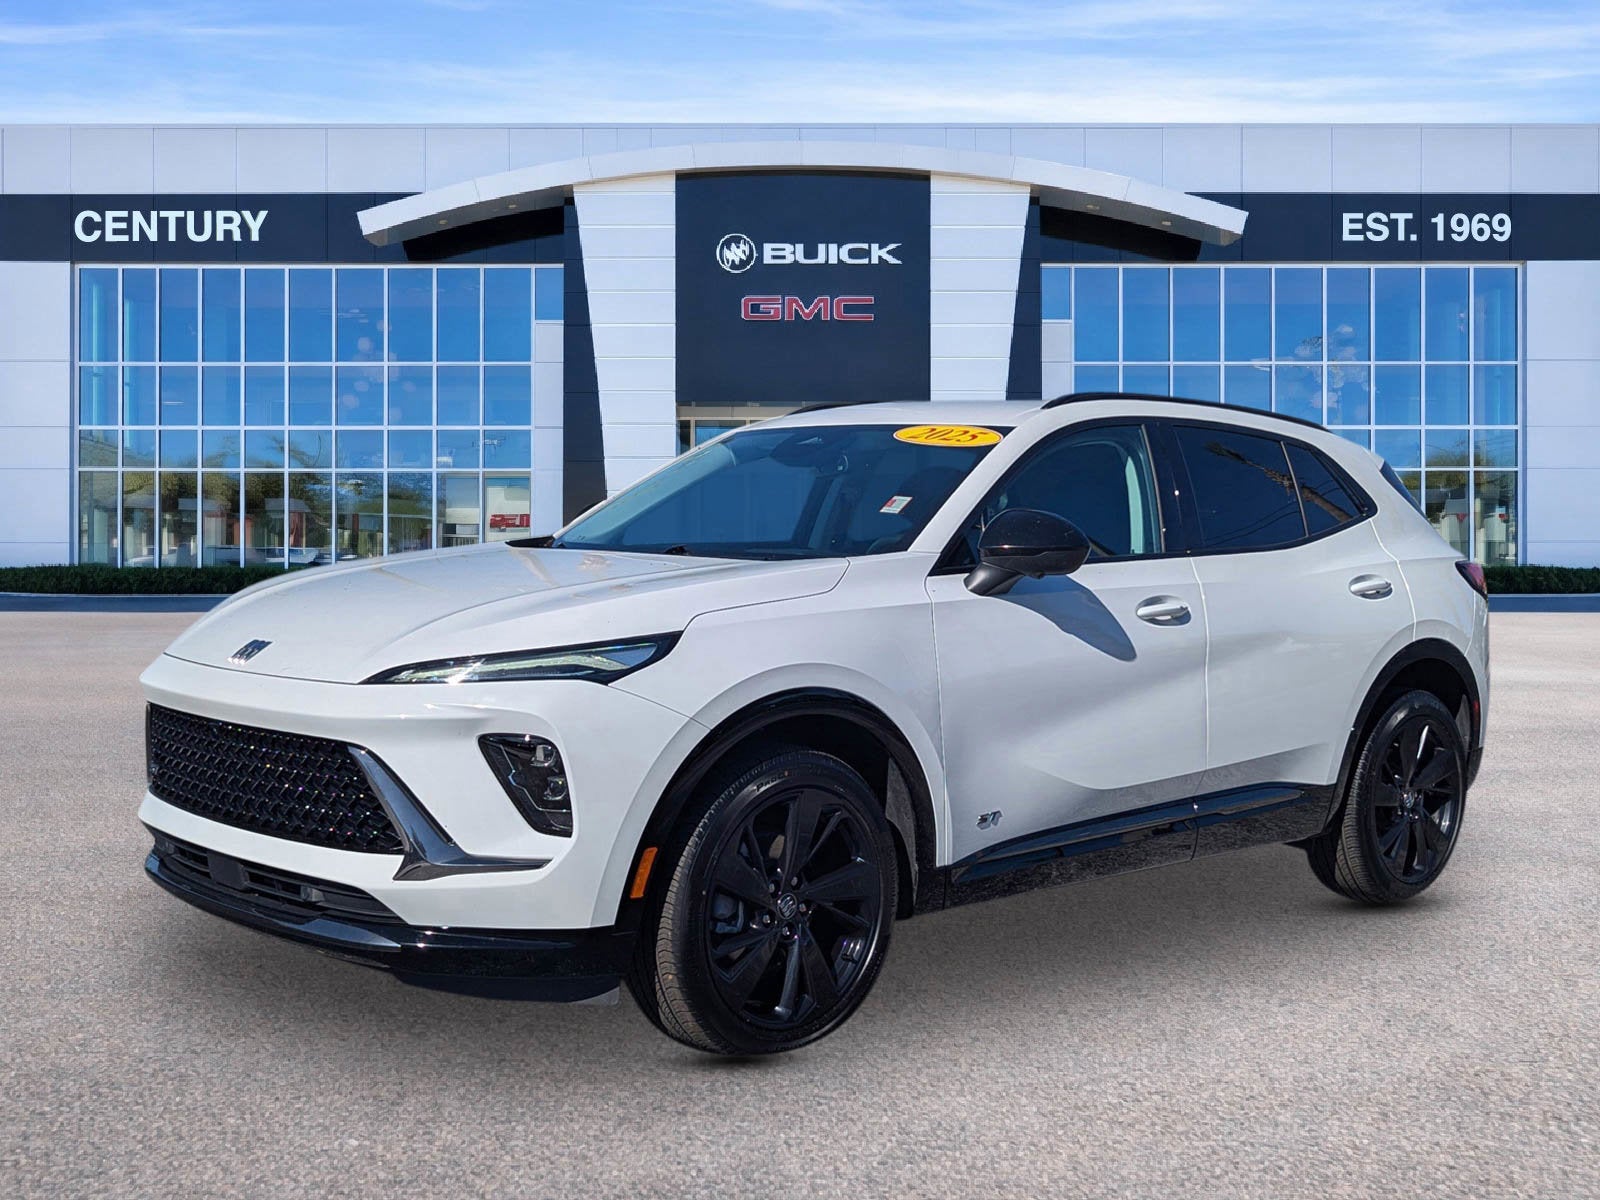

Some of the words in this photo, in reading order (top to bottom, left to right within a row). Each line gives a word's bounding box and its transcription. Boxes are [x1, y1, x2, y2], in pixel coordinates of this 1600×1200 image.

[74, 210, 269, 242] CENTURY
[1342, 212, 1417, 242] EST.
[1431, 213, 1512, 242] 1969
[762, 243, 902, 264] BUICK
[741, 295, 874, 321] GMC
[906, 427, 989, 442] 2025
